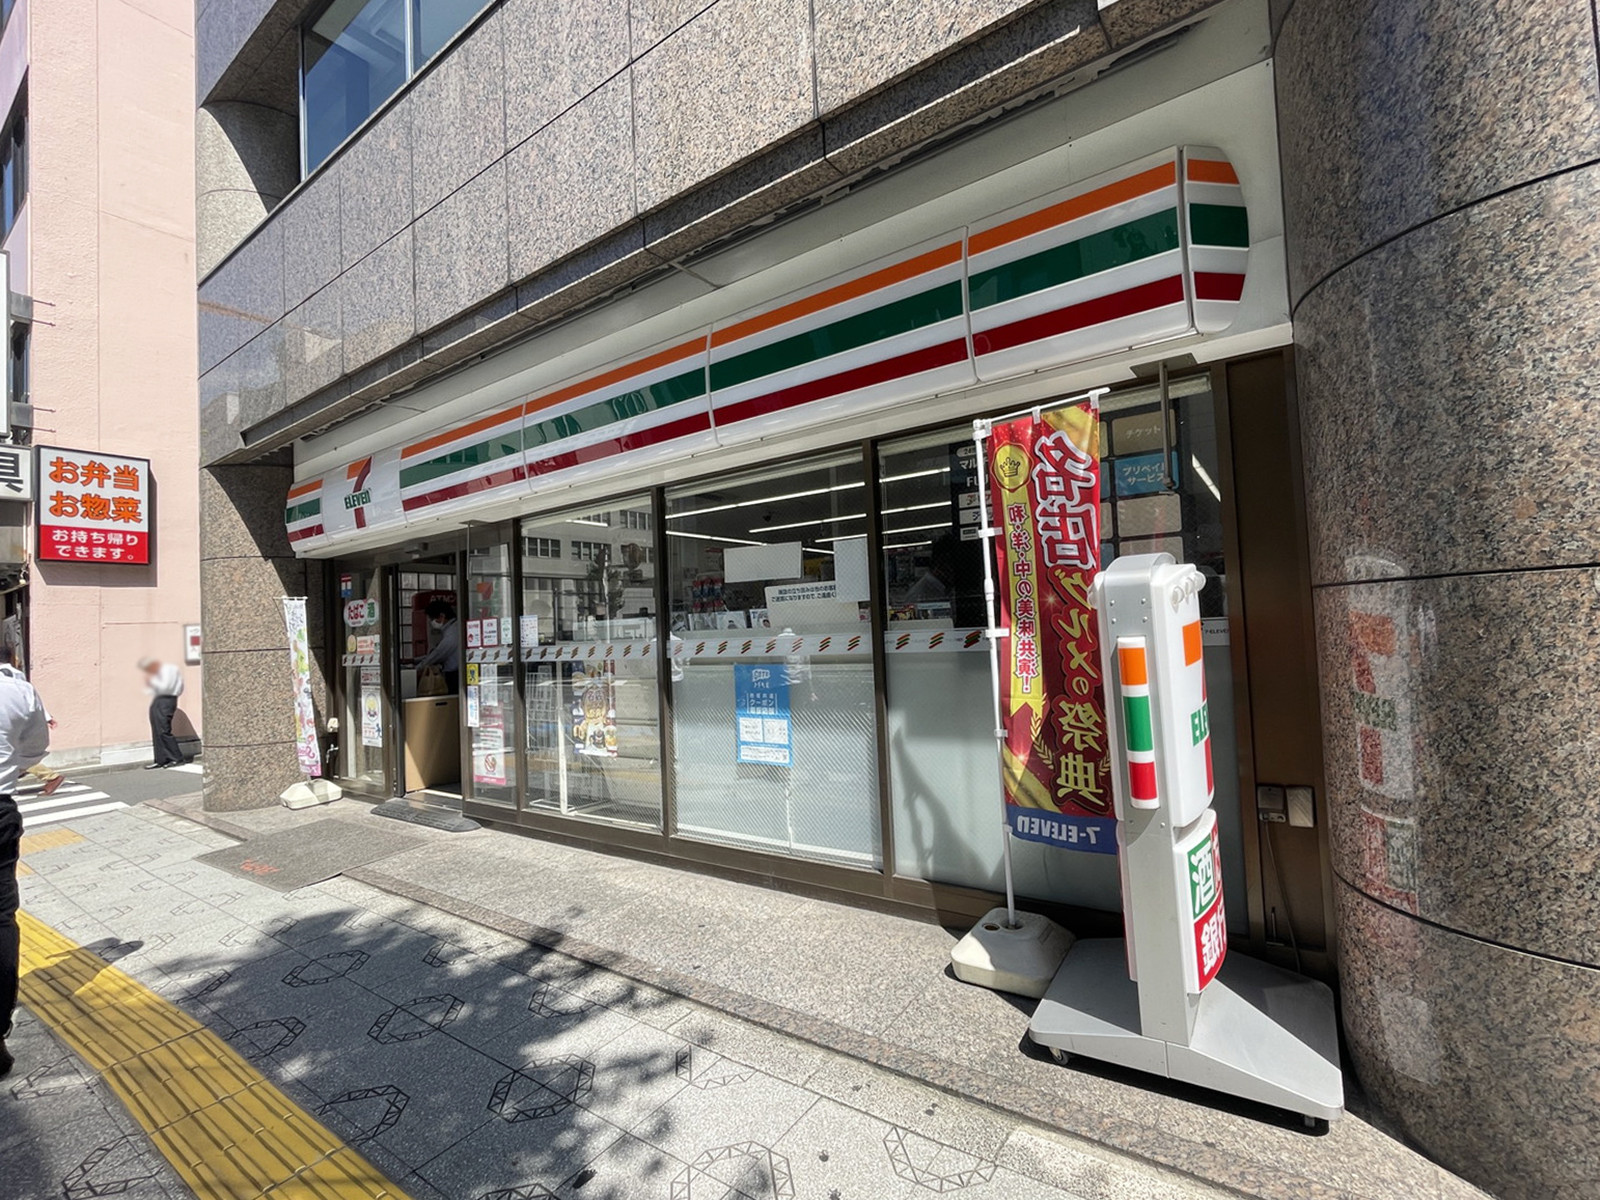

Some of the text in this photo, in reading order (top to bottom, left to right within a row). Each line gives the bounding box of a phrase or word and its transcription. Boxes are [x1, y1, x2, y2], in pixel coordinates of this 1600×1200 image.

[1125, 425, 1161, 440] チケット
[49, 456, 140, 491] お弁当
[1122, 461, 1166, 476] プリペイ
[49, 491, 143, 523] お惣菜
[52, 529, 139, 546] お持ち帰り
[54, 545, 134, 560] できます。
[1190, 839, 1215, 914] 酒
